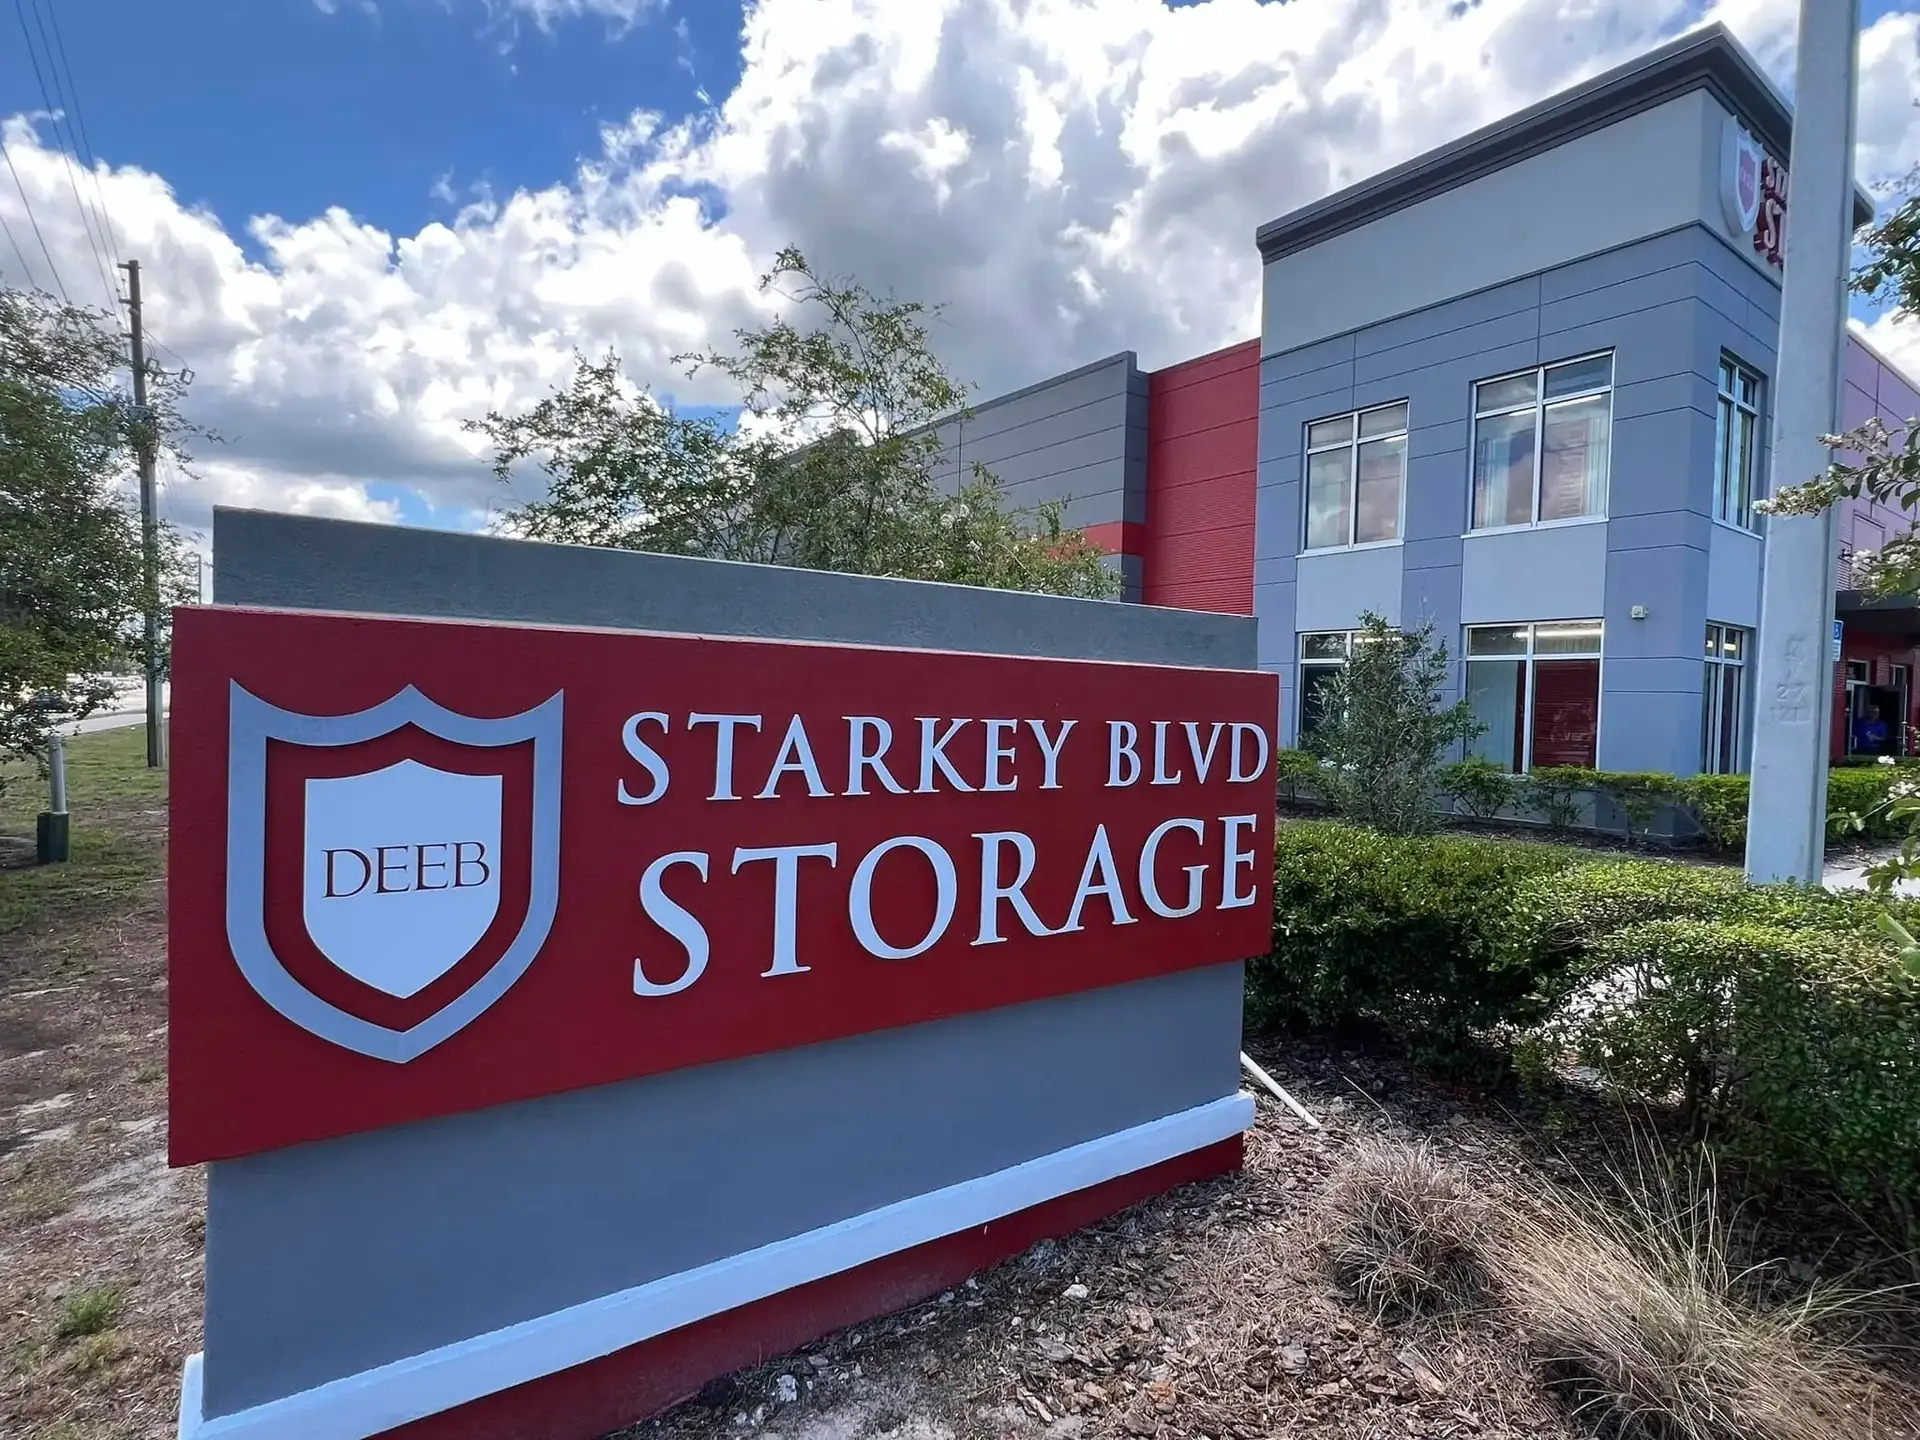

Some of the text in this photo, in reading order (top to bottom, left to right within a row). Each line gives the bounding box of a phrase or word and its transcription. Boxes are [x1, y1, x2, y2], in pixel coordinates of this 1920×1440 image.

[617, 710, 1269, 806] STARKEY BLVD
[321, 841, 491, 899] DEEB
[633, 813, 1258, 998] STORAGE
